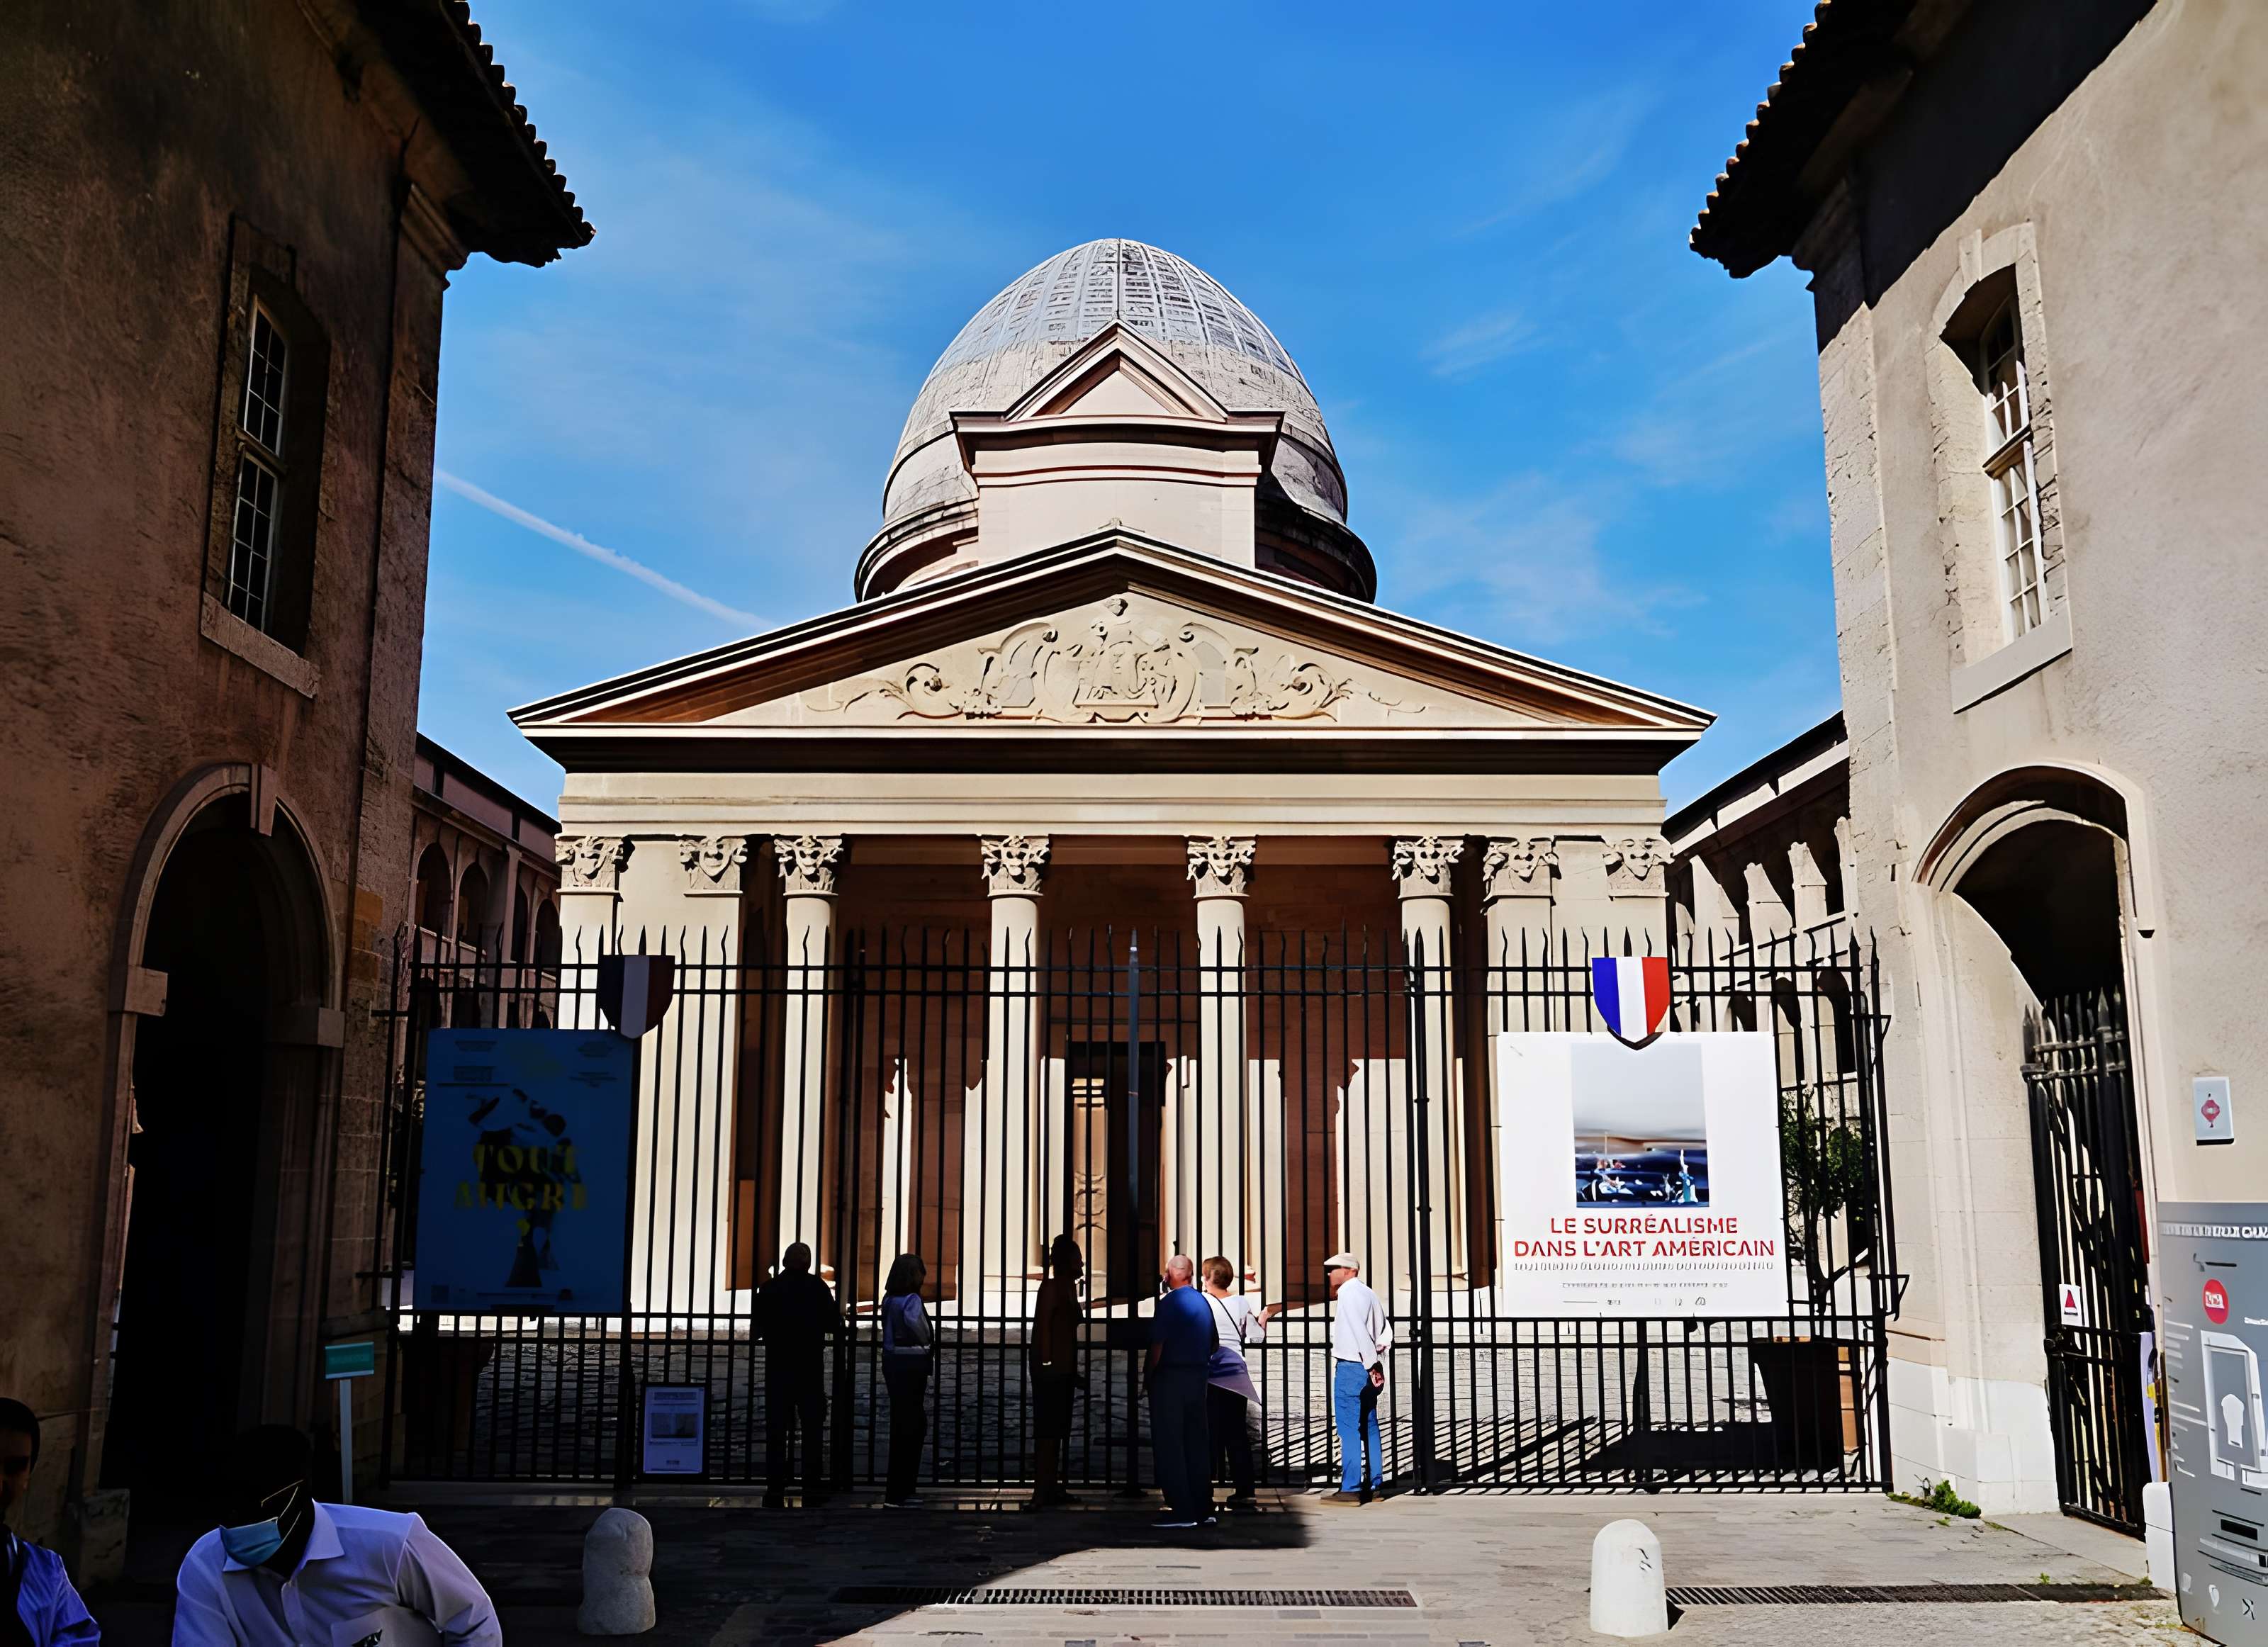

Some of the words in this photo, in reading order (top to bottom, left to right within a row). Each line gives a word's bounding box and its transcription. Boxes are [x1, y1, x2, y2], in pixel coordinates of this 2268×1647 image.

[1551, 1218, 1577, 1234] LE
[1583, 1214, 1738, 1234] SURRÉALISME
[1514, 1240, 1577, 1257] DANS
[1583, 1240, 1646, 1257] L'ART
[1652, 1237, 1775, 1257] AMÉRICAIN
